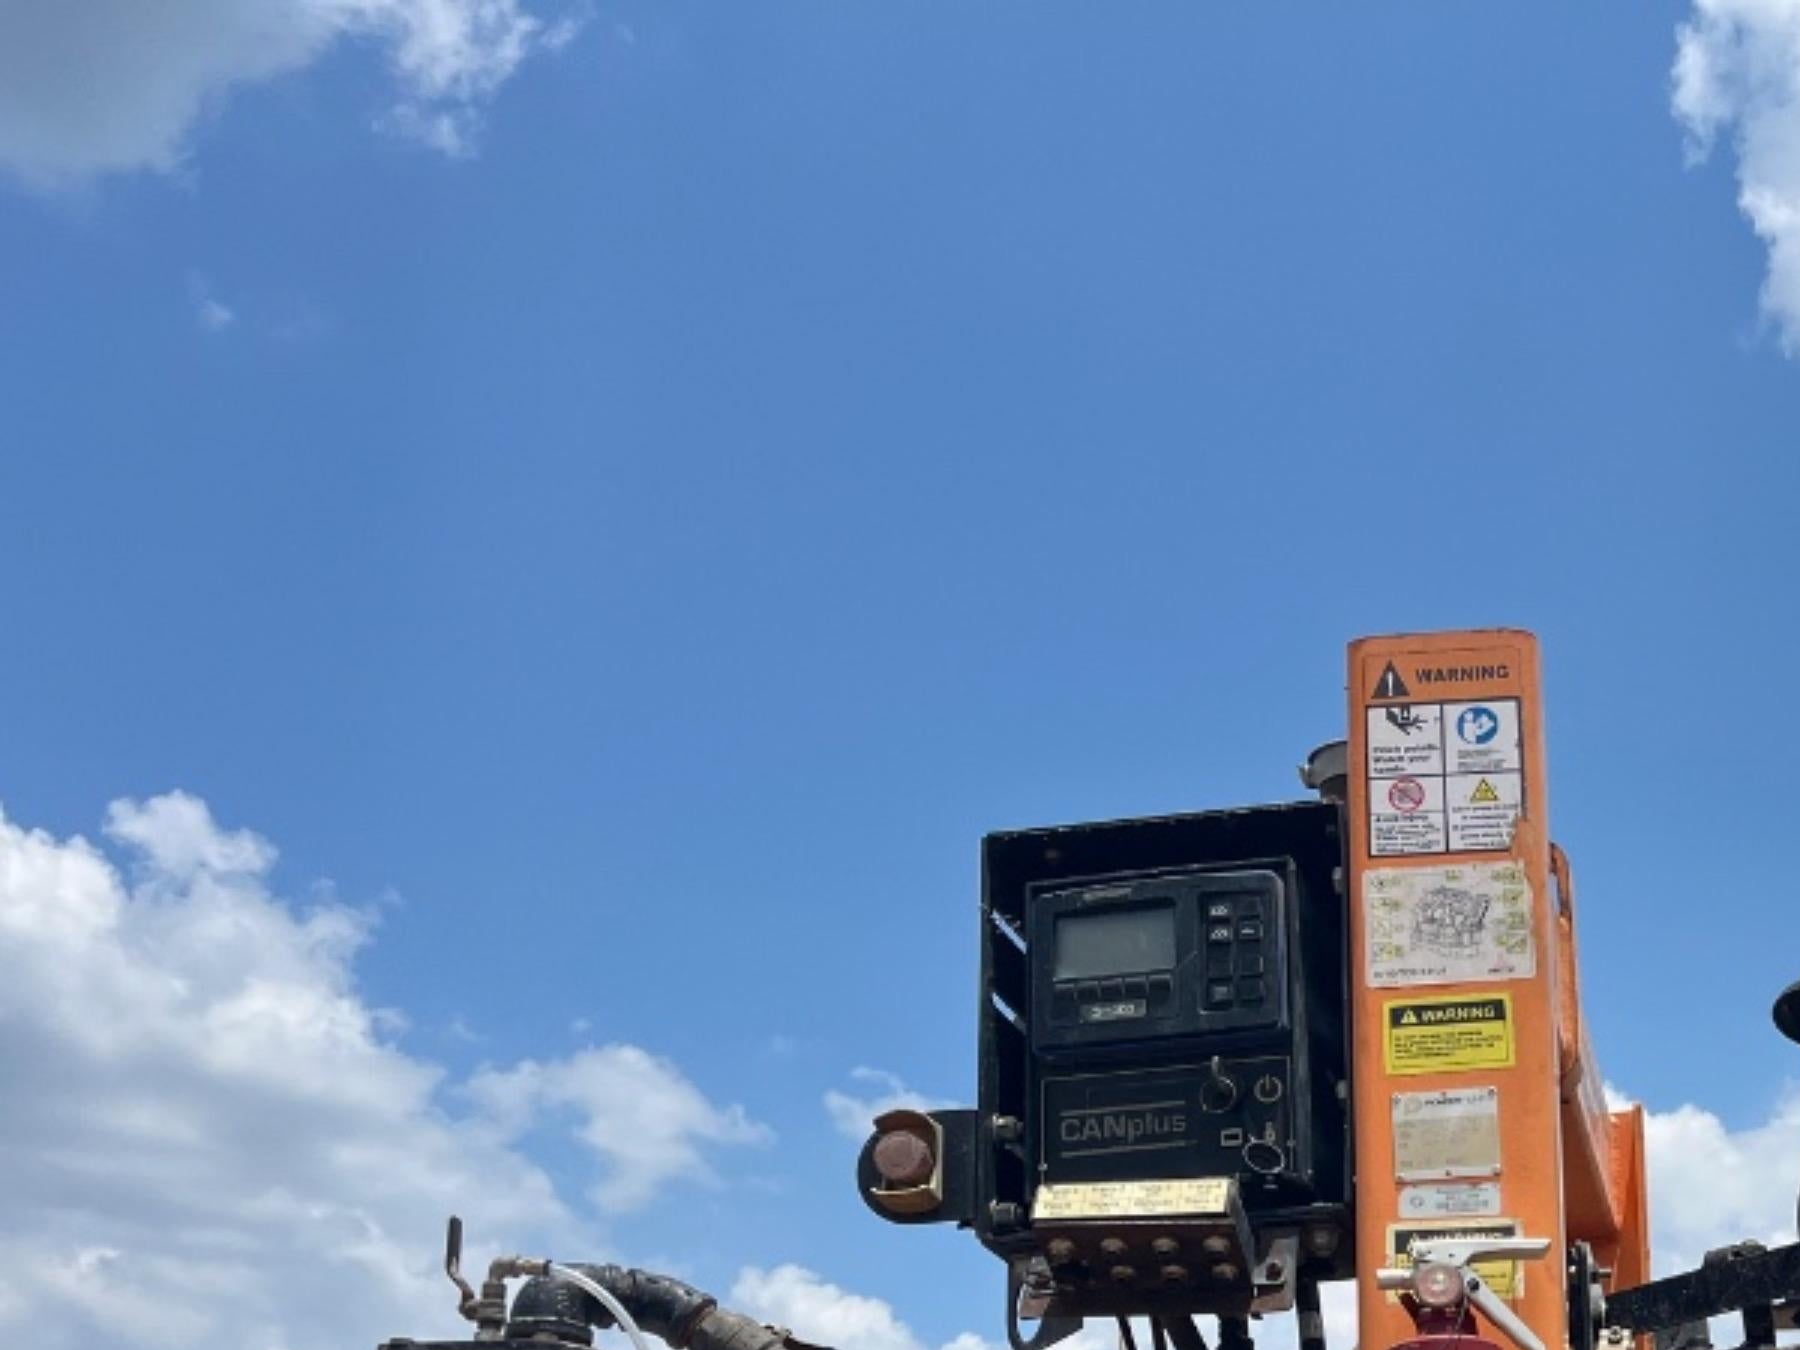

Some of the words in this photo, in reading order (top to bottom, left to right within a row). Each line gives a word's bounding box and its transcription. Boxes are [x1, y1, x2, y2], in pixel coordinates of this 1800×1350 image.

[1415, 665, 1510, 683] WARNING
[1421, 1006, 1496, 1023] WARNING
[1060, 1111, 1187, 1145] CANplus
